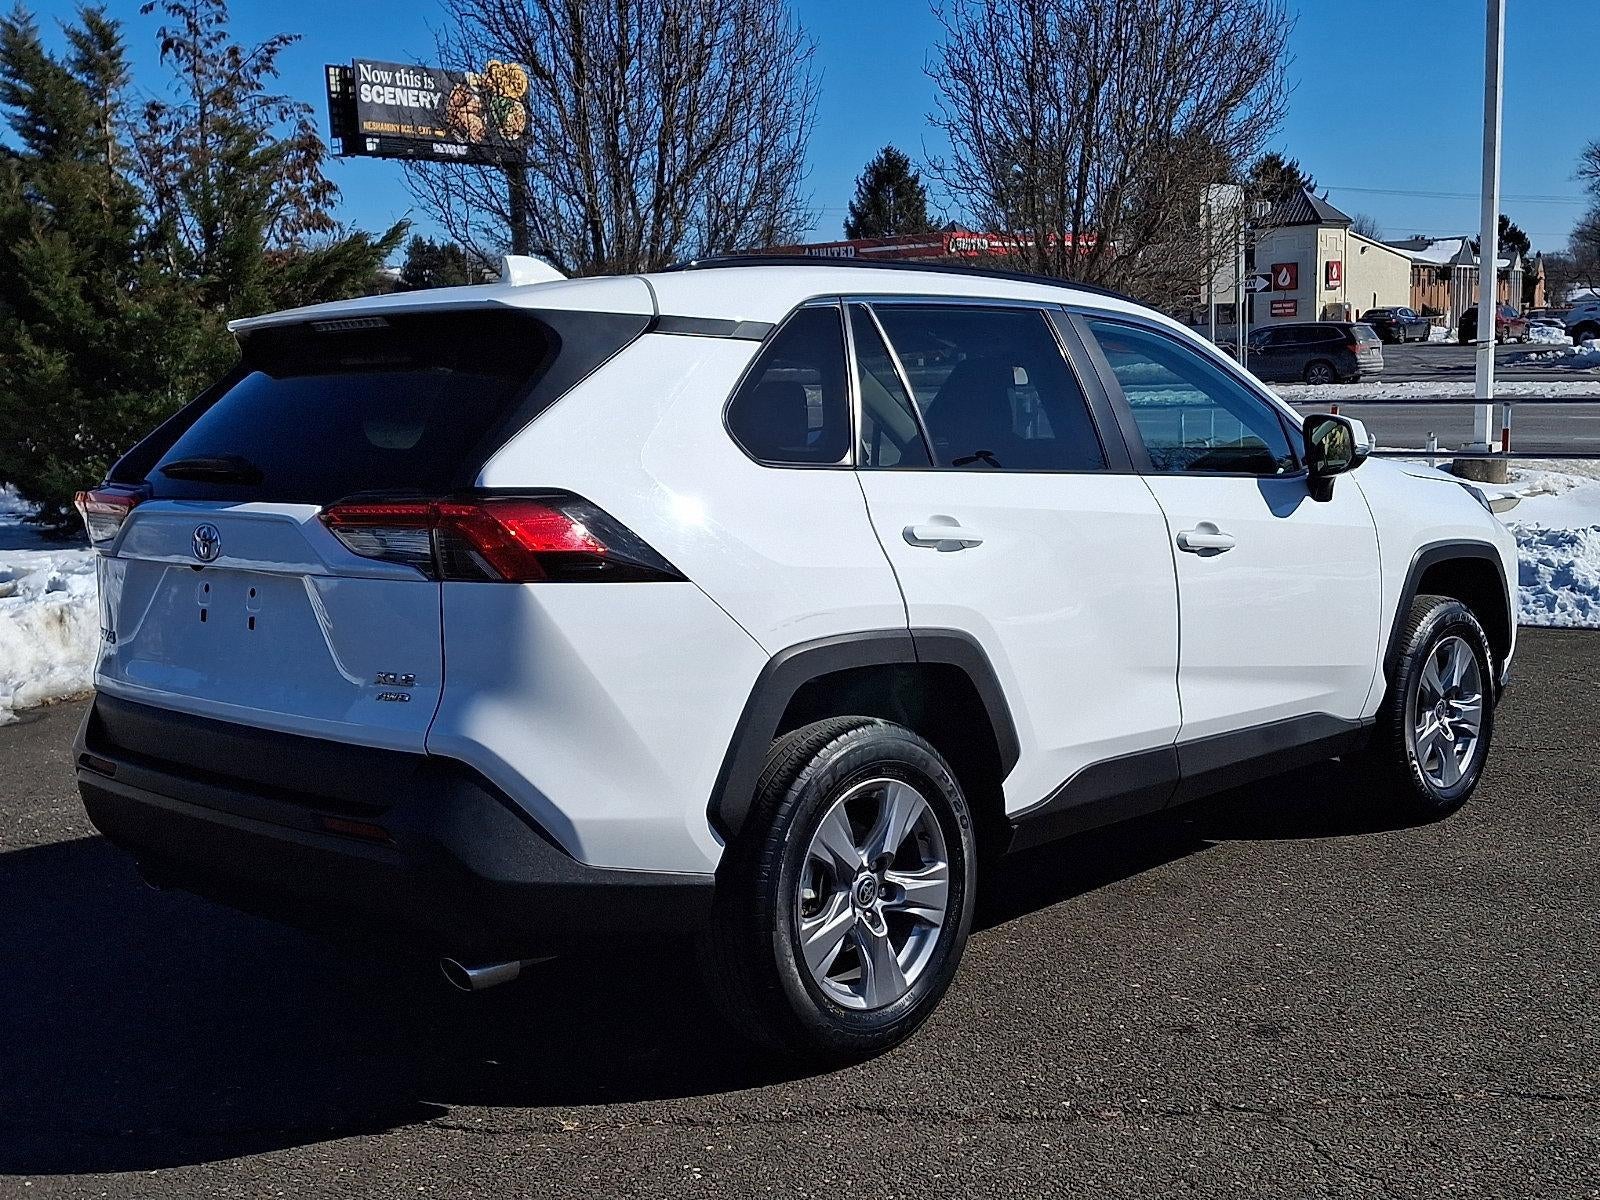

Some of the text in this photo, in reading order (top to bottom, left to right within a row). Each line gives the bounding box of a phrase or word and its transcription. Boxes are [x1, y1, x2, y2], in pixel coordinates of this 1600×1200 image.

[358, 63, 435, 90] Now this is
[360, 83, 442, 110] SCENERY
[374, 671, 416, 687] XLE
[375, 692, 411, 703] AWD
